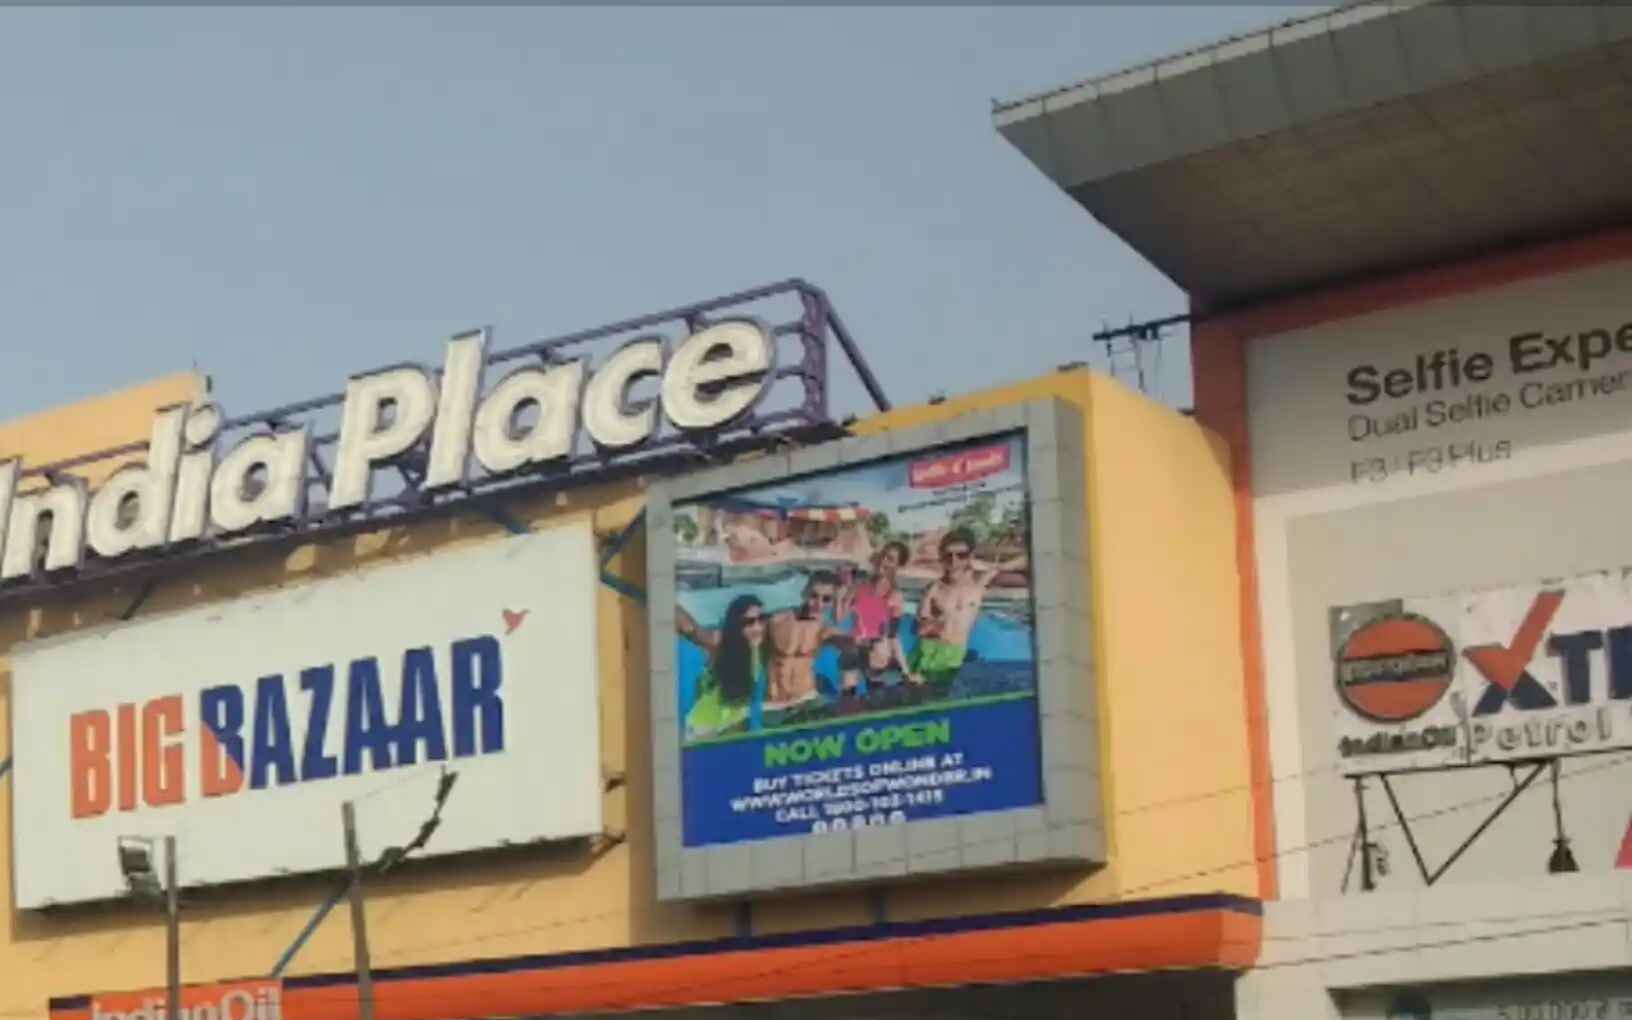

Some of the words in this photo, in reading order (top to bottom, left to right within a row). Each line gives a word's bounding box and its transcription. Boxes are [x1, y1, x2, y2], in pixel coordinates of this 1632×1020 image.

[1346, 348, 1494, 405] Selfie
[329, 315, 773, 508] Place
[1348, 408, 1418, 442] Dual
[1425, 392, 1512, 428] Selfie
[70, 694, 187, 819] BIG
[199, 634, 505, 798] BAZAAR
[764, 734, 846, 769] NOW
[856, 718, 950, 754] OPEN
[1471, 706, 1614, 751] Petrol
[753, 775, 788, 793] BUY
[941, 752, 964, 767] AT
[775, 804, 819, 822] CALL
